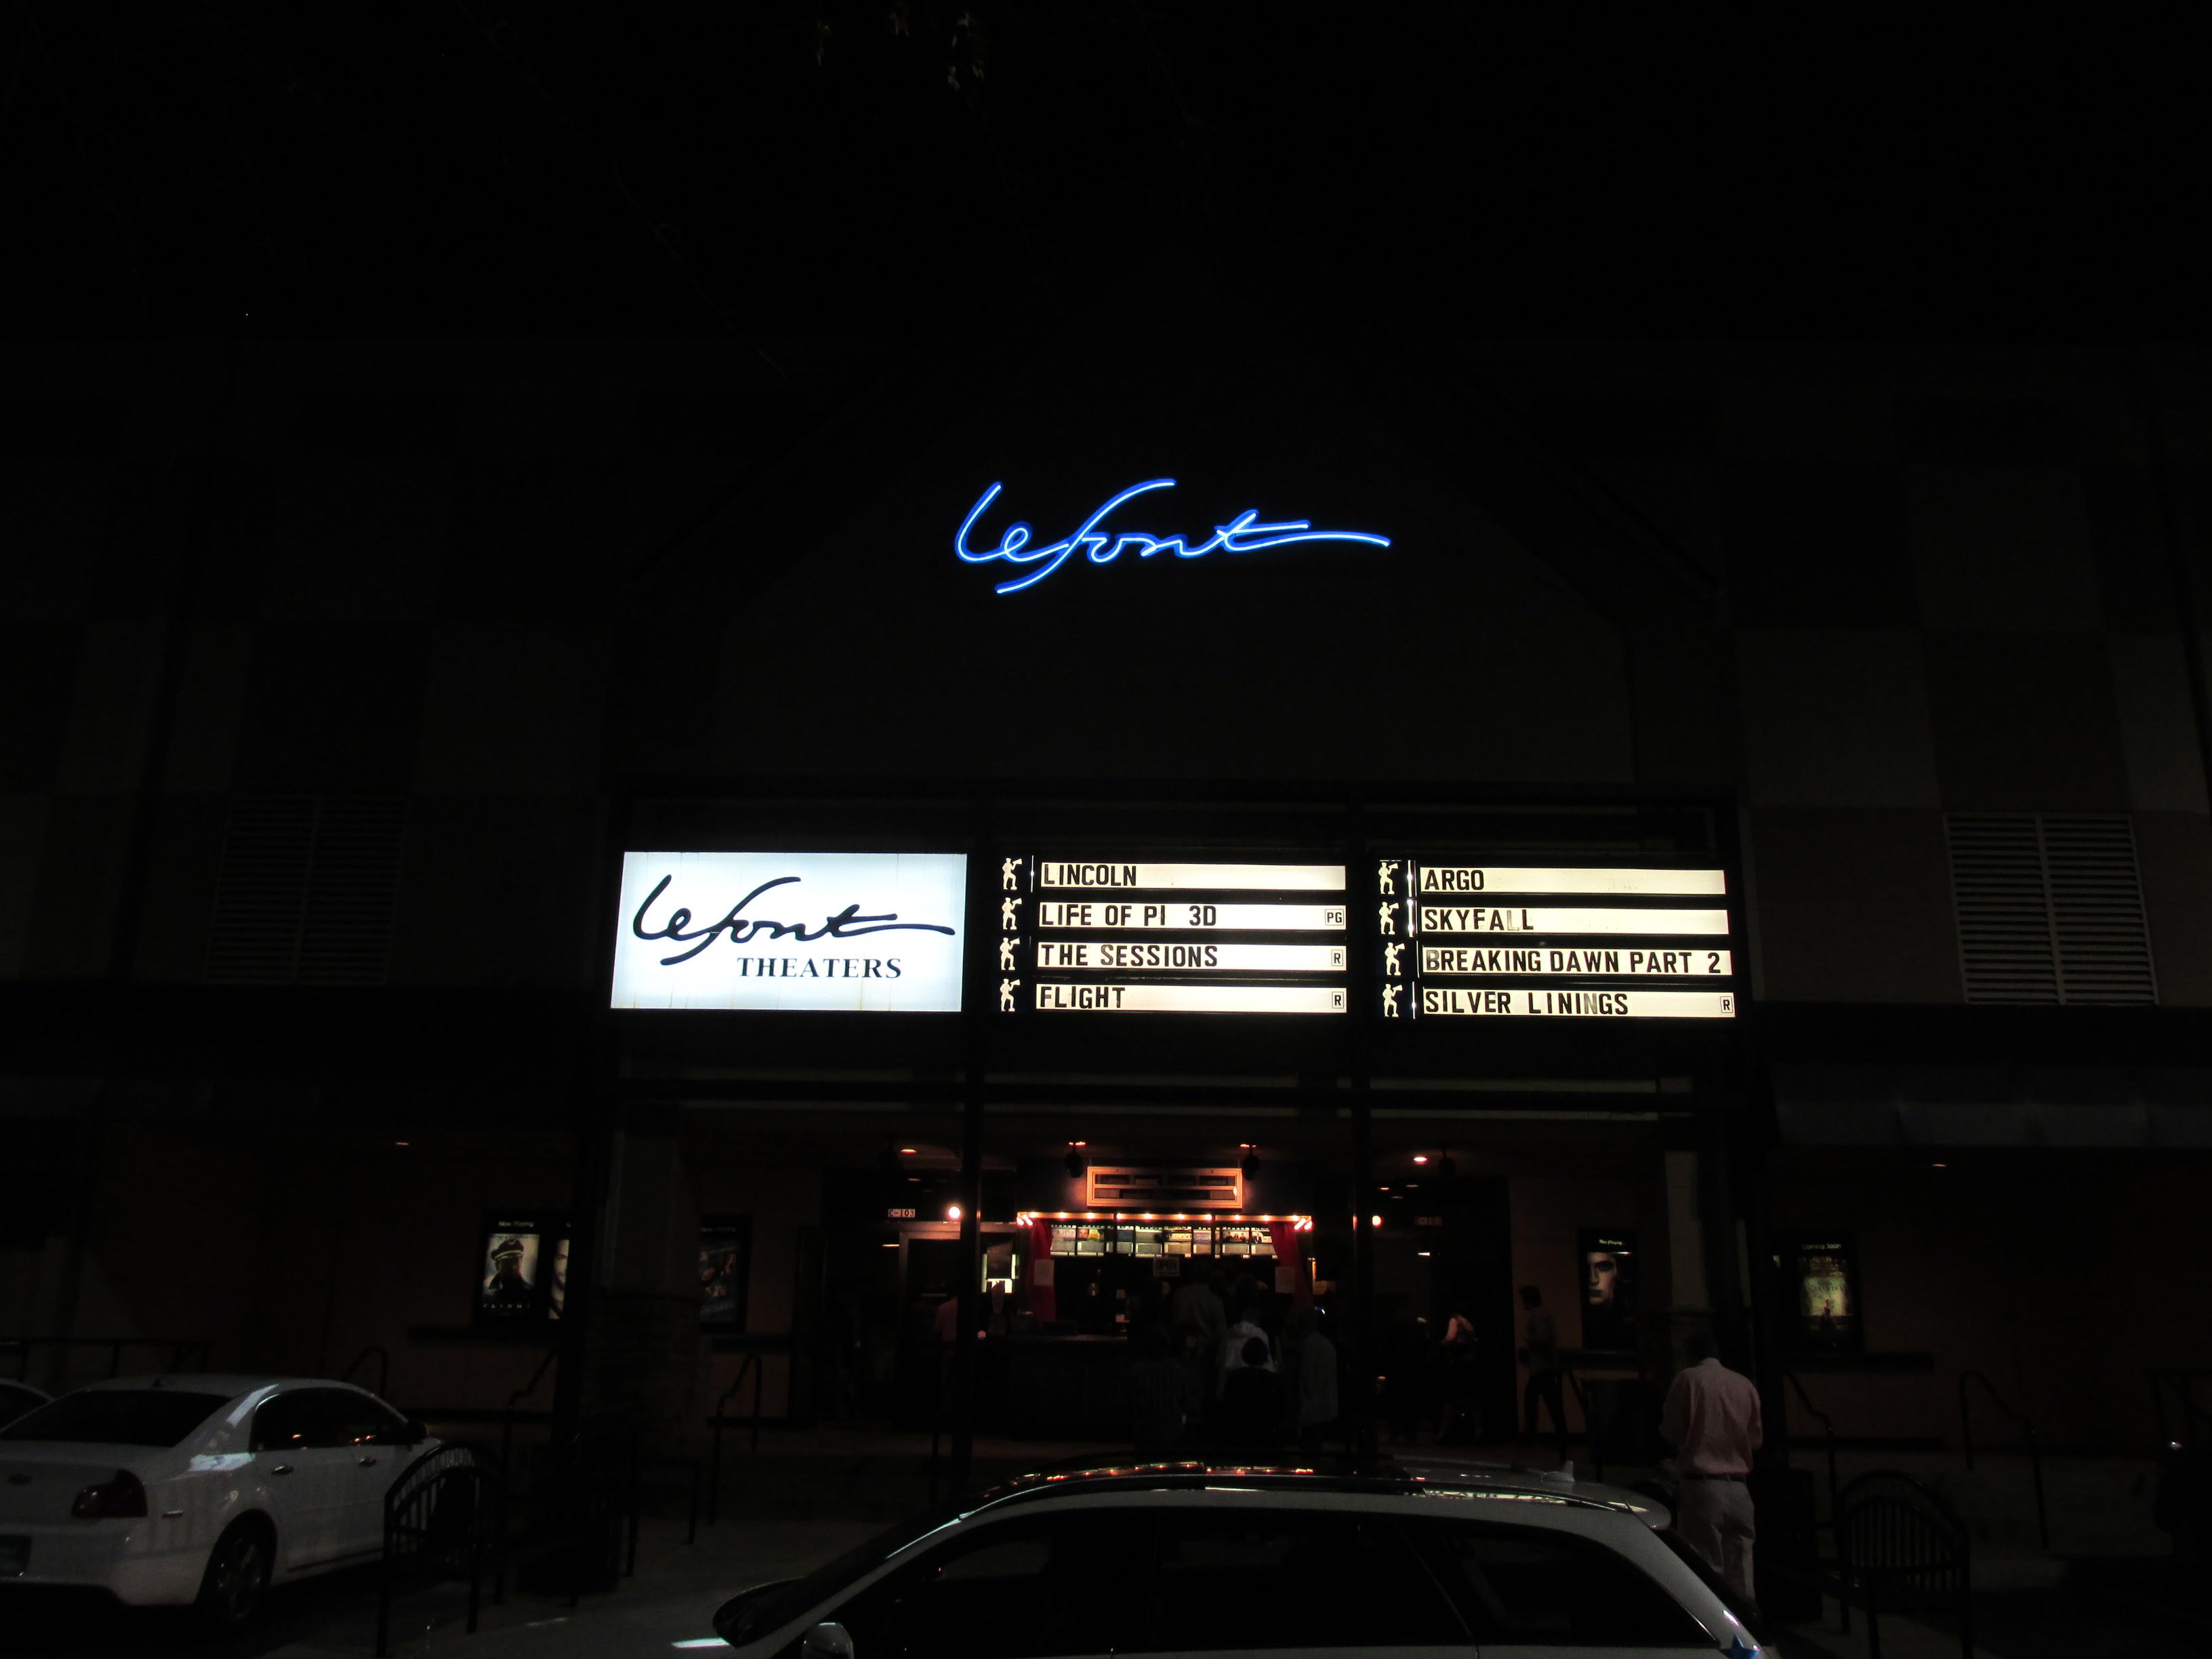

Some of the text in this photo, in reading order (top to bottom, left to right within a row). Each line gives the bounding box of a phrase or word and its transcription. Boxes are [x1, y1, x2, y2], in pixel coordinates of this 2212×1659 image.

[1044, 864, 1136, 887] LINCOLN
[1425, 869, 1484, 890] ARGO
[1042, 904, 1342, 926] LIFE OF PI 3D PG
[1425, 909, 1534, 930] SKYFALL
[1042, 944, 1341, 967] THE SESSIONS R
[1427, 950, 1721, 973] BREAKING DAWN PART 2
[737, 958, 901, 979] THEATERS
[1040, 986, 1342, 1009] FLIGHT R
[1426, 991, 1732, 1015] SILVER LININGS R
